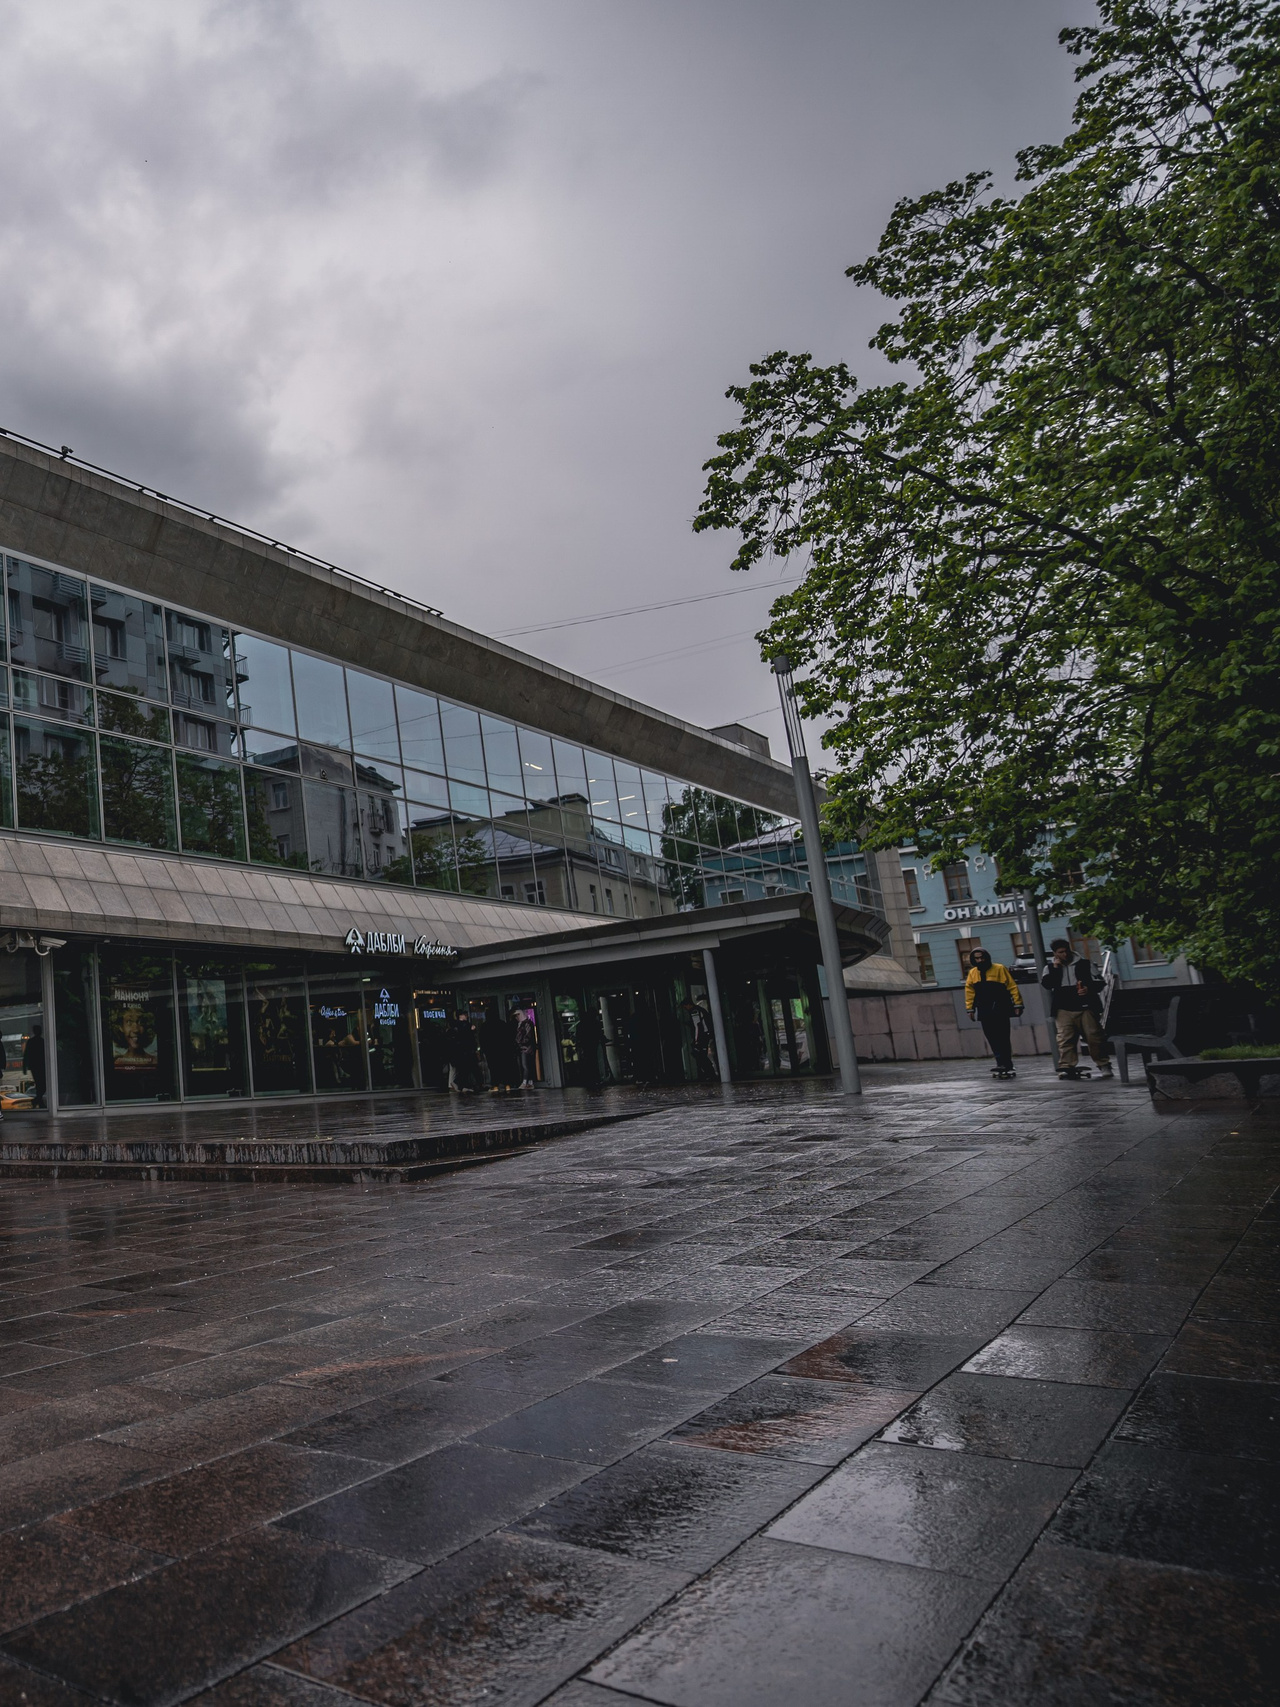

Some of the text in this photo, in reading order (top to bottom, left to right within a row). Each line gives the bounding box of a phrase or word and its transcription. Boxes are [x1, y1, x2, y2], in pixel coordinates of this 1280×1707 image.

[943, 896, 1055, 921] ОН КЛИНК
[366, 931, 458, 959] ДАБЛБИ Кофейня
[114, 988, 150, 1002] МАНЮНЯ
[374, 1003, 400, 1019] ДАБЛБИ
